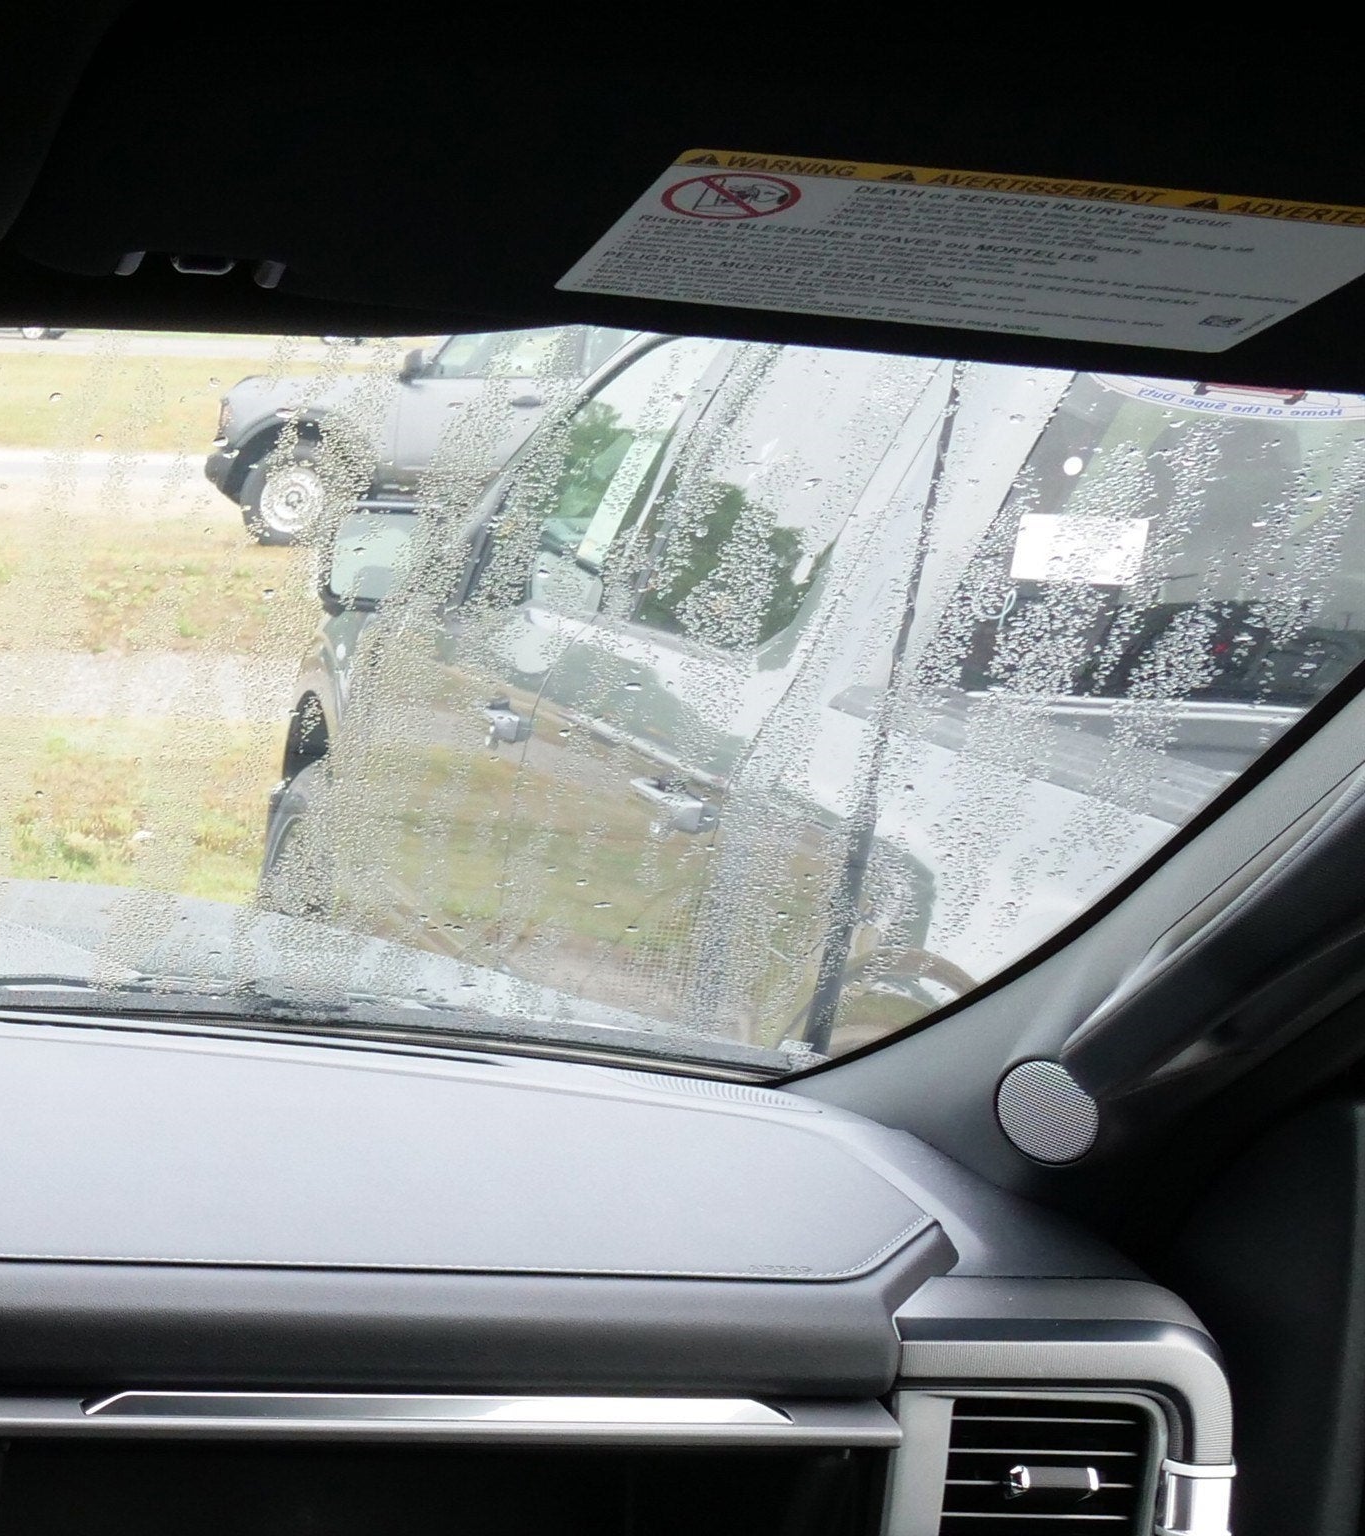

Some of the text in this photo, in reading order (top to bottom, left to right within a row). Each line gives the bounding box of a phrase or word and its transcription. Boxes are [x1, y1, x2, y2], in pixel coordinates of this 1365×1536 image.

[726, 155, 857, 177] WARNING
[852, 185, 926, 198] DEATH
[926, 192, 951, 201] or
[952, 194, 1049, 209] SERIOUS
[1049, 202, 1130, 217] INJURY
[928, 172, 1161, 203] AVERTISSEMENT
